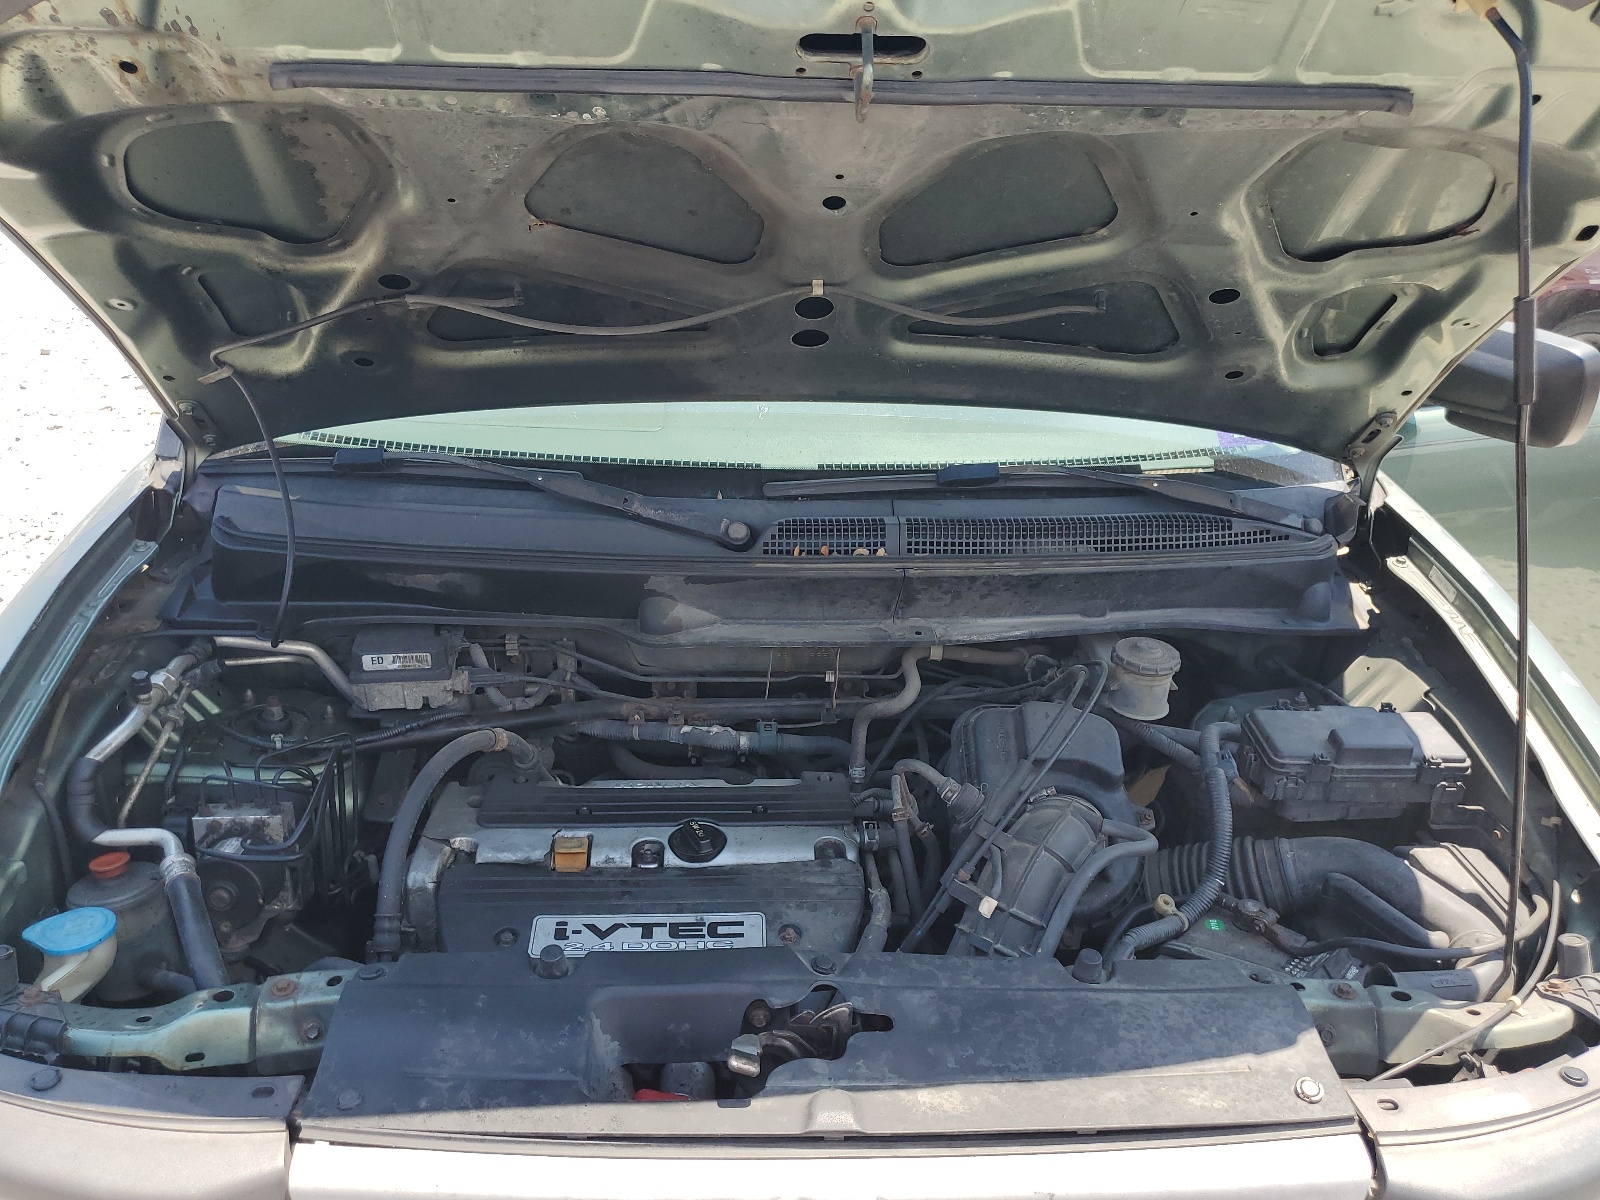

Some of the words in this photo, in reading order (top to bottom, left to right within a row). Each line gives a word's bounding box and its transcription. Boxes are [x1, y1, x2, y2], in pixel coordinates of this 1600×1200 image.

[370, 656, 384, 665] ED
[553, 920, 745, 941] i-VTEC
[564, 941, 615, 952] 2.4
[621, 940, 734, 951] DOHC
